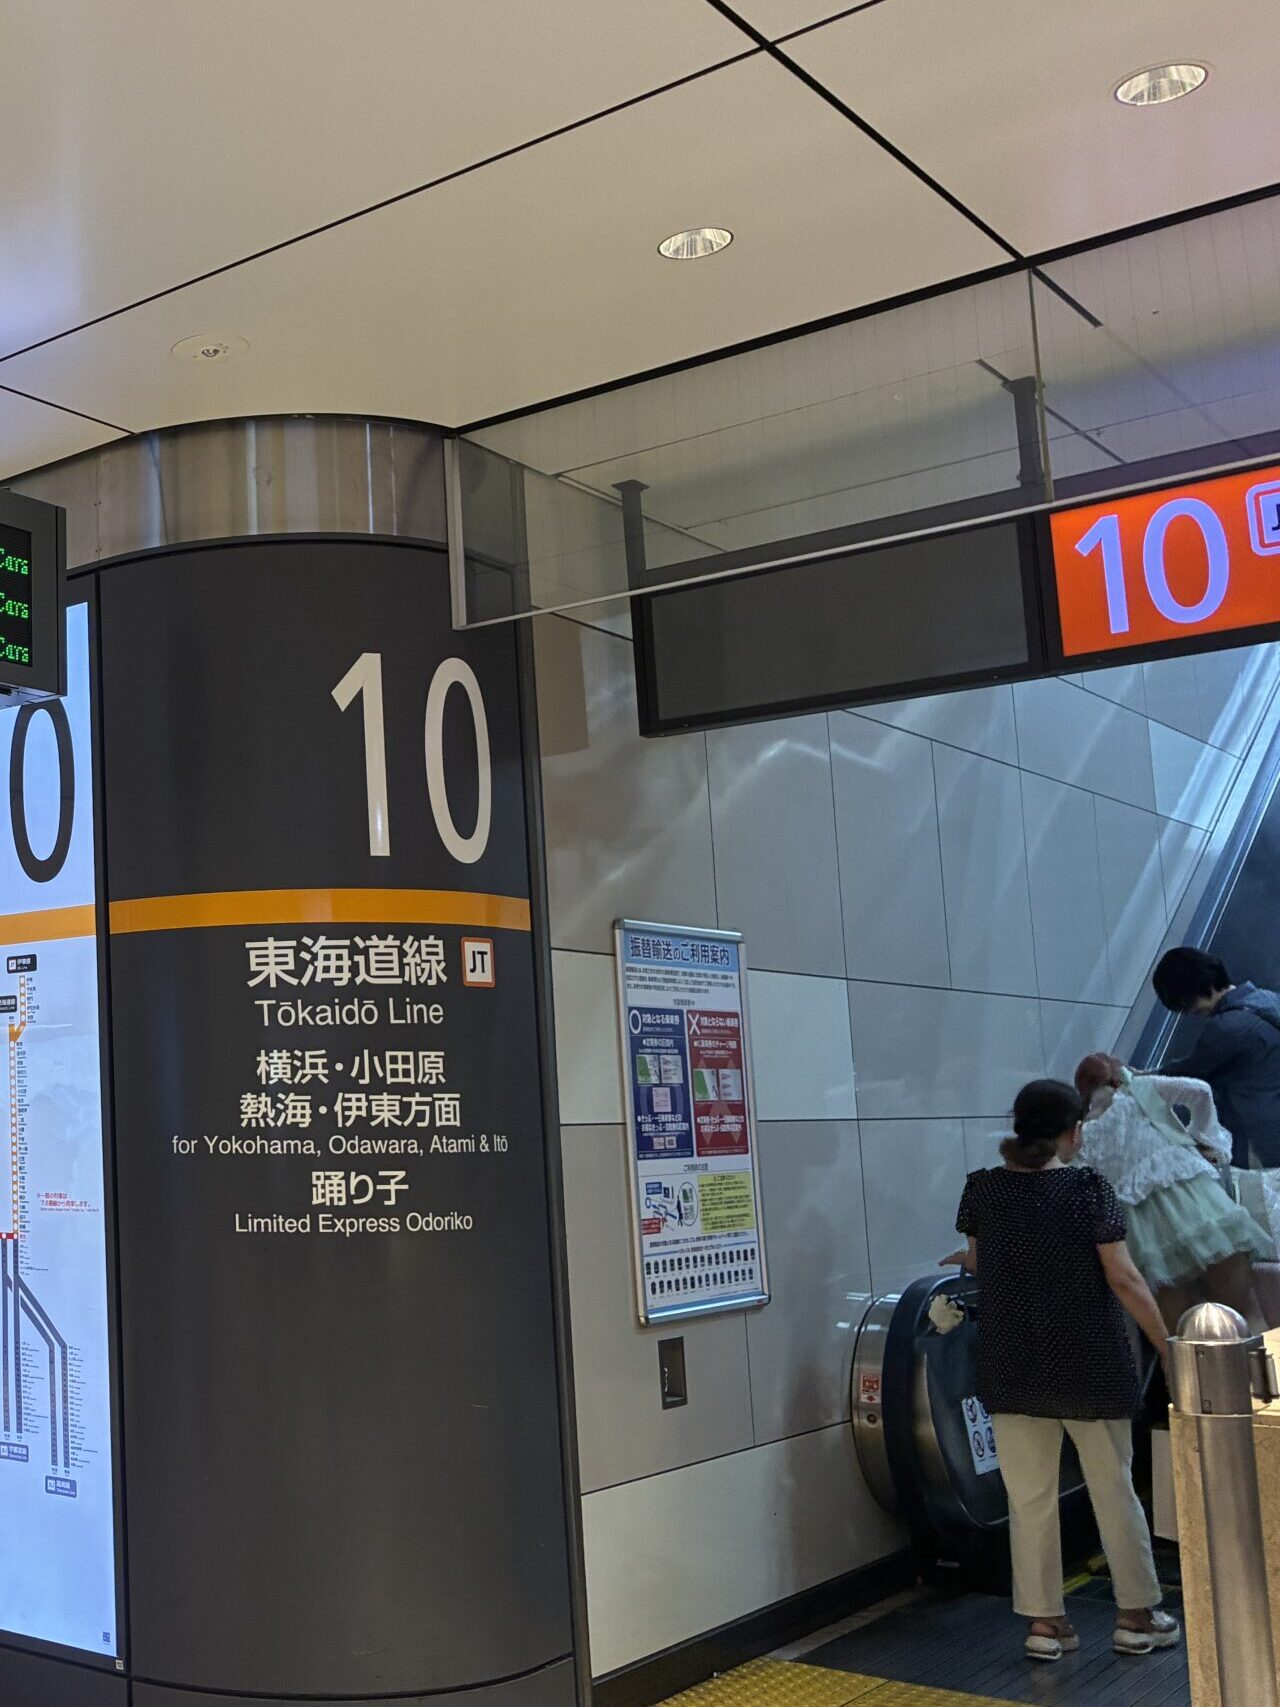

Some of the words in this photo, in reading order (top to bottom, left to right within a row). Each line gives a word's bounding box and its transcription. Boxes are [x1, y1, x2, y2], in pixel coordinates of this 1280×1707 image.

[1075, 497, 1230, 634] 10
[331, 652, 492, 864] 10
[245, 936, 448, 988] 東海道線
[468, 949, 489, 975] JT
[630, 935, 730, 966] 振替輸送のご利用案内
[254, 997, 379, 1026] Tōkaidō
[389, 997, 445, 1025] Line
[256, 1048, 447, 1086] 横浜・小田原
[239, 1092, 462, 1129] 熱海・伊東方面
[172, 1135, 200, 1155] for
[203, 1135, 322, 1158] Yokohama,
[328, 1134, 424, 1158] Odawara,
[429, 1134, 476, 1154] Atami
[480, 1135, 491, 1154] &
[493, 1133, 509, 1153] Itō
[311, 1170, 409, 1206] 踊り子
[235, 1212, 311, 1234] Limited
[318, 1213, 401, 1237] Express
[406, 1211, 473, 1233] Odoriko
